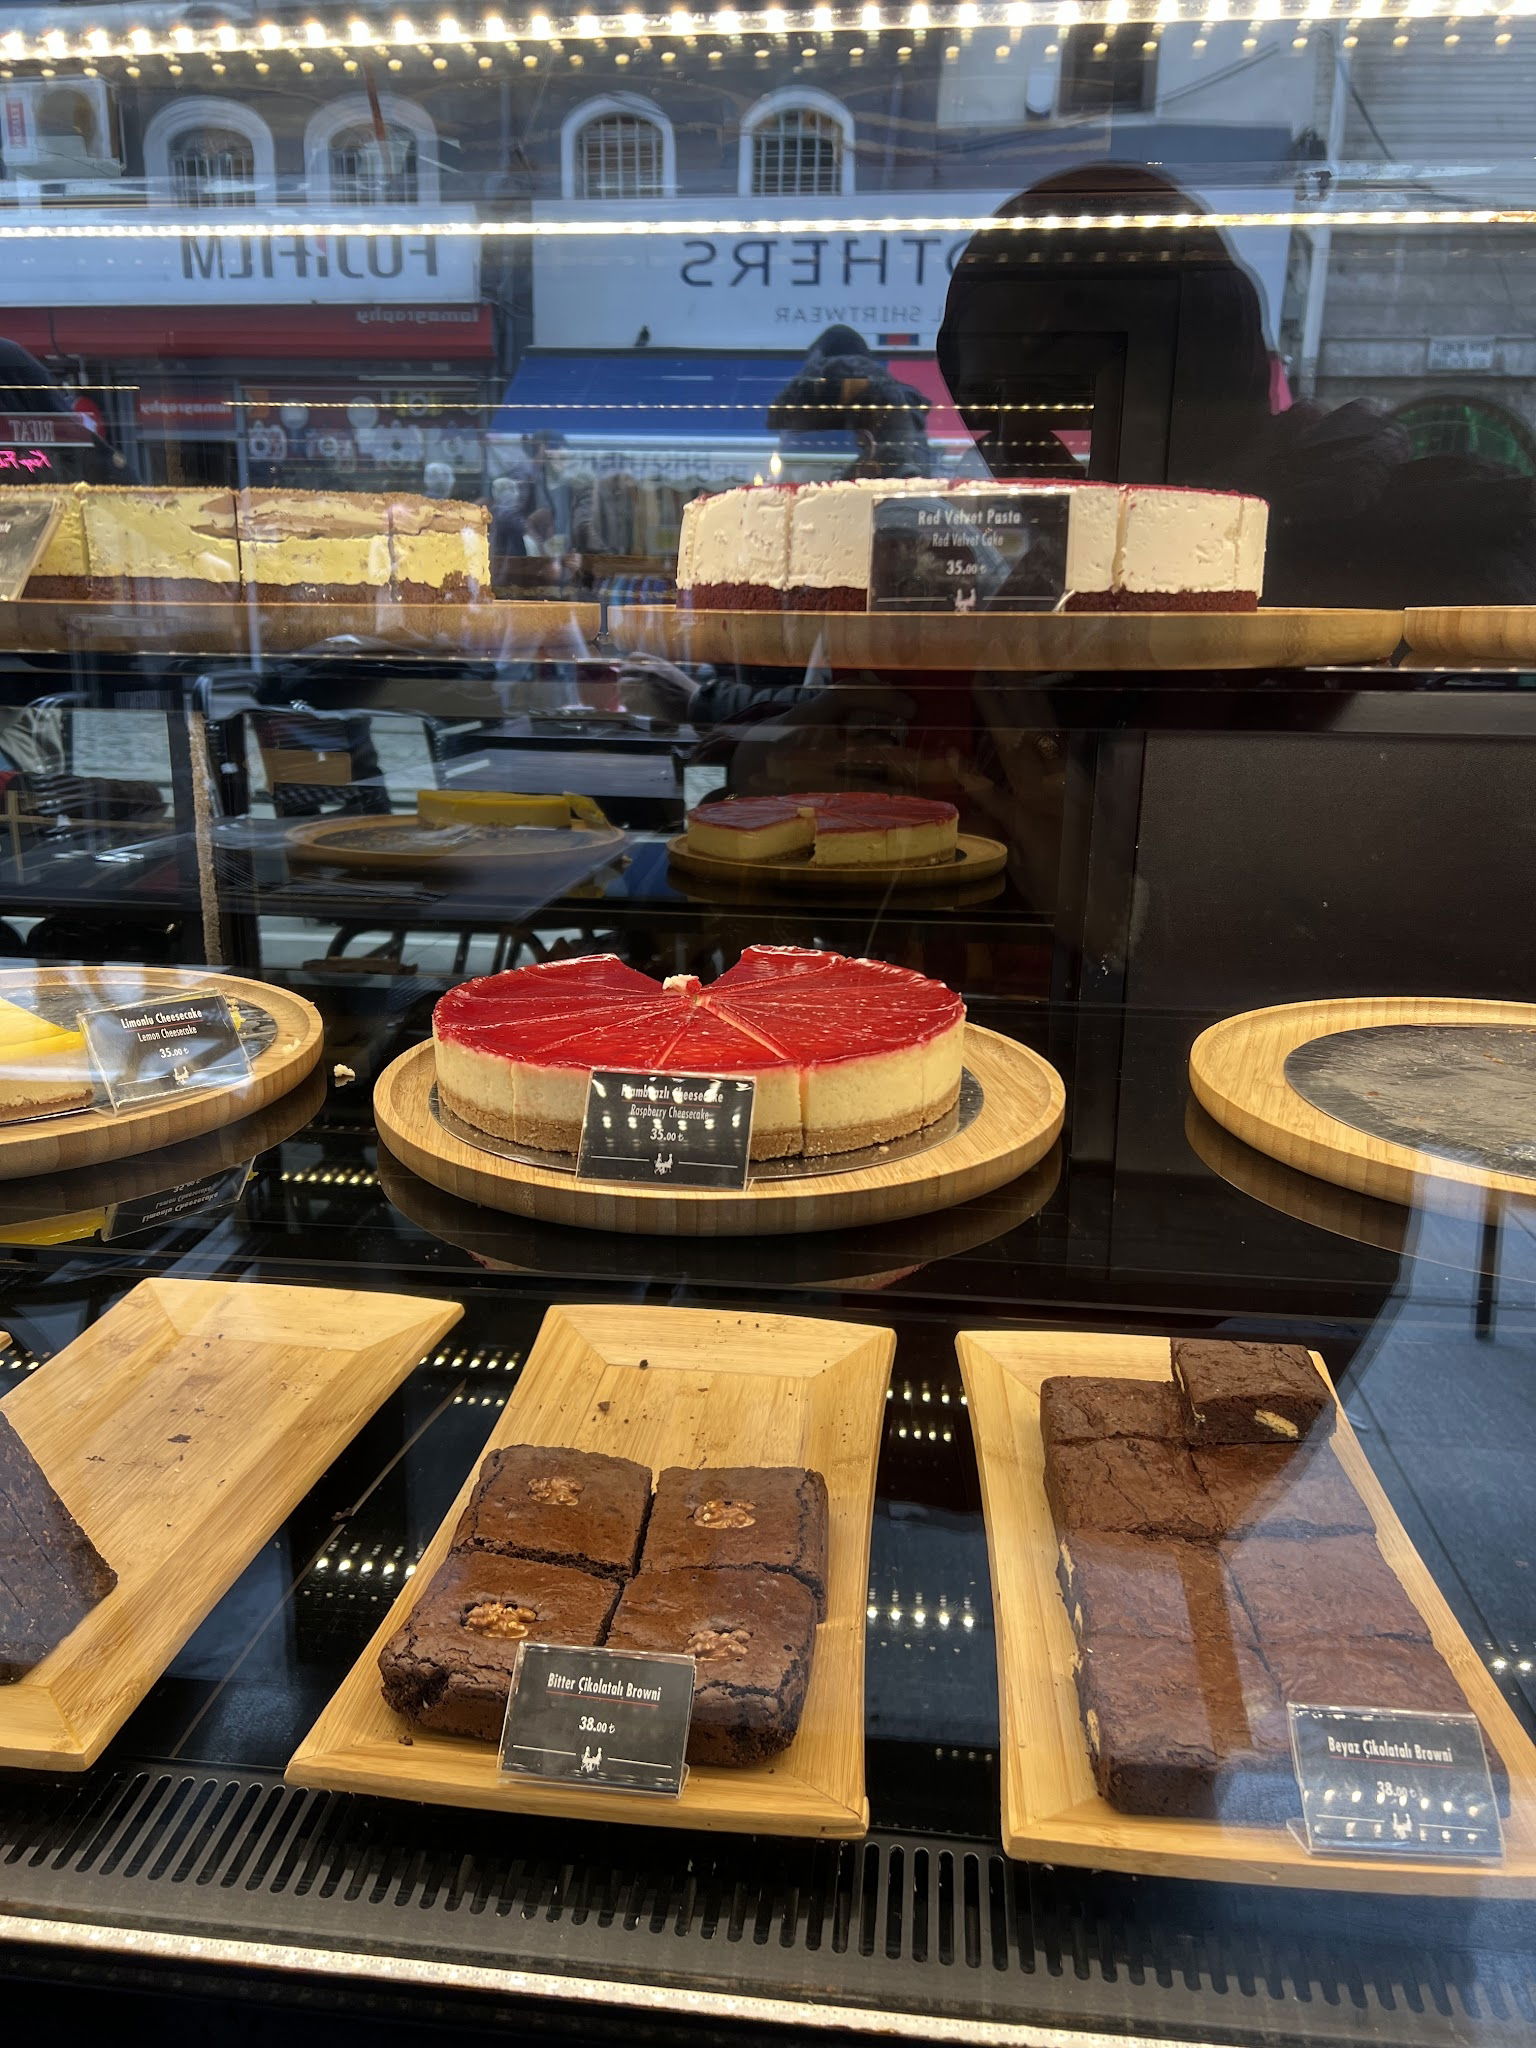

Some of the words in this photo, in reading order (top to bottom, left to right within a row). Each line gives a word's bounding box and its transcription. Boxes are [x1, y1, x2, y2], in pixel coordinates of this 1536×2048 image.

[918, 509, 941, 525] Red
[945, 510, 983, 525] Velvet
[987, 508, 1022, 525] Pasta
[932, 533, 950, 547] Red
[952, 532, 979, 547] Velvet
[981, 531, 1004, 547] Cake
[121, 1014, 155, 1029] Limonlu
[155, 1008, 203, 1024] Cheesecake
[137, 1030, 161, 1043] Lemon
[161, 1025, 198, 1039] Cheesecake
[631, 1104, 667, 1119] Raspberry
[668, 1106, 709, 1121] Cheesecake
[547, 1673, 576, 1690] Bitter
[578, 1676, 624, 1696] Çikolatalı
[626, 1682, 662, 1701] Browni
[1328, 1736, 1361, 1757] Beyaz
[1362, 1739, 1412, 1760] Çikolatalı
[1414, 1744, 1453, 1763] Browni
